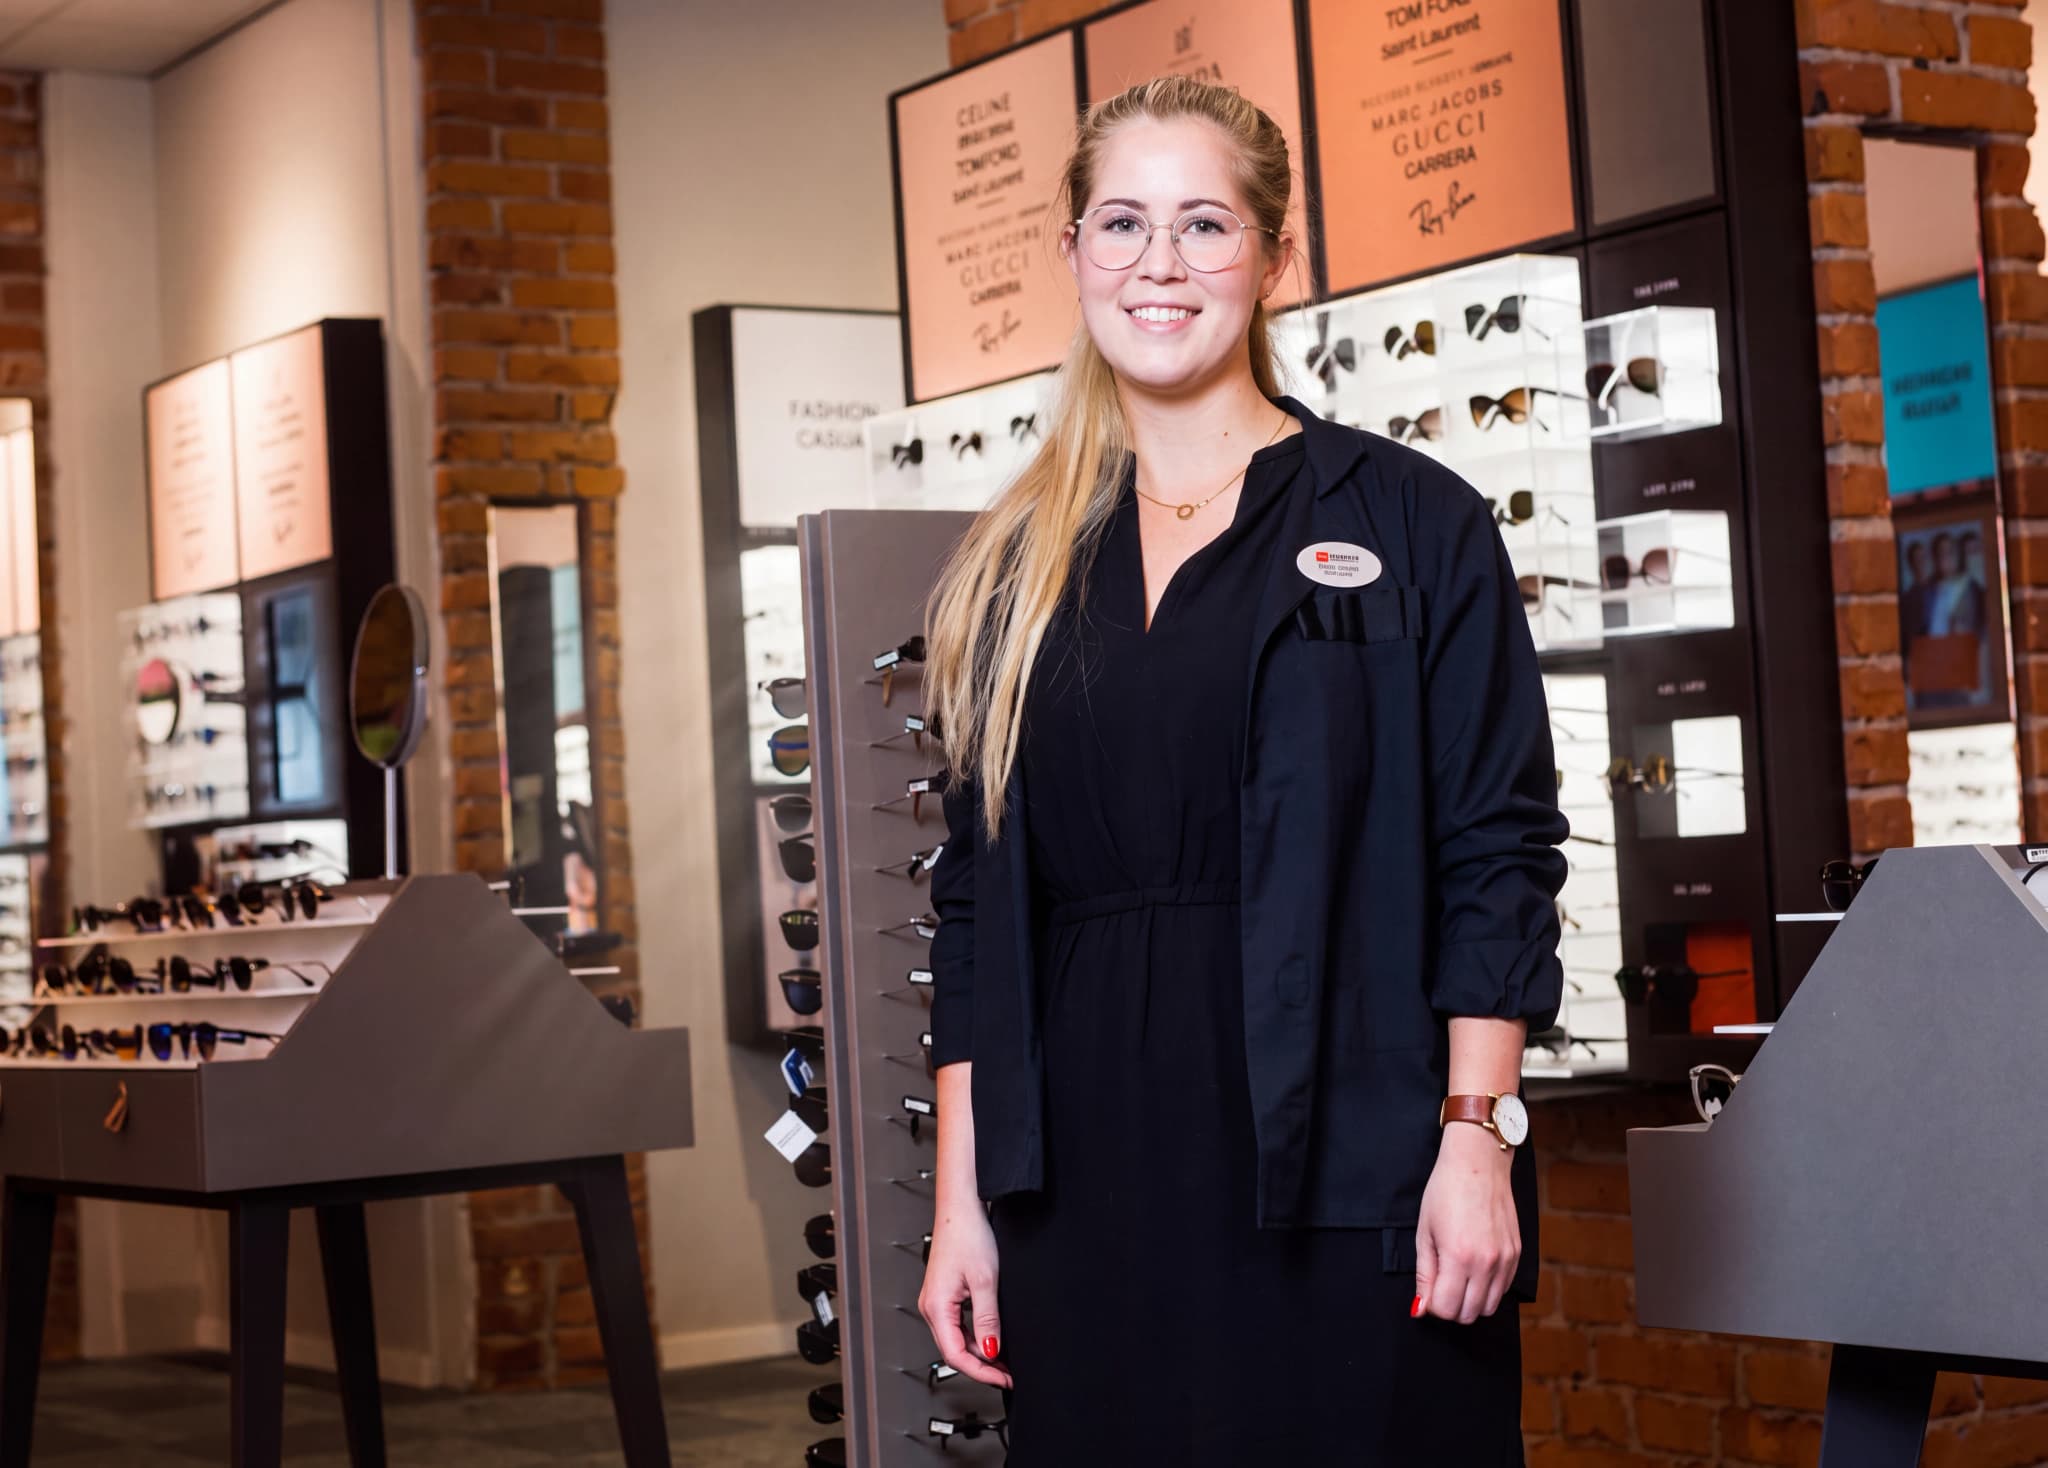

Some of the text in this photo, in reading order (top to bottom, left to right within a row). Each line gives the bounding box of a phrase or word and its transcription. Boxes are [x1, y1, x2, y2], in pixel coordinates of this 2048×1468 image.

[1385, 1, 1422, 29] TOM
[1420, 12, 1481, 48] Laurent
[1371, 104, 1421, 132] MARC
[1429, 78, 1503, 116] JACOBS
[1392, 109, 1485, 156] GUCCI
[1404, 144, 1477, 179] CARRERA
